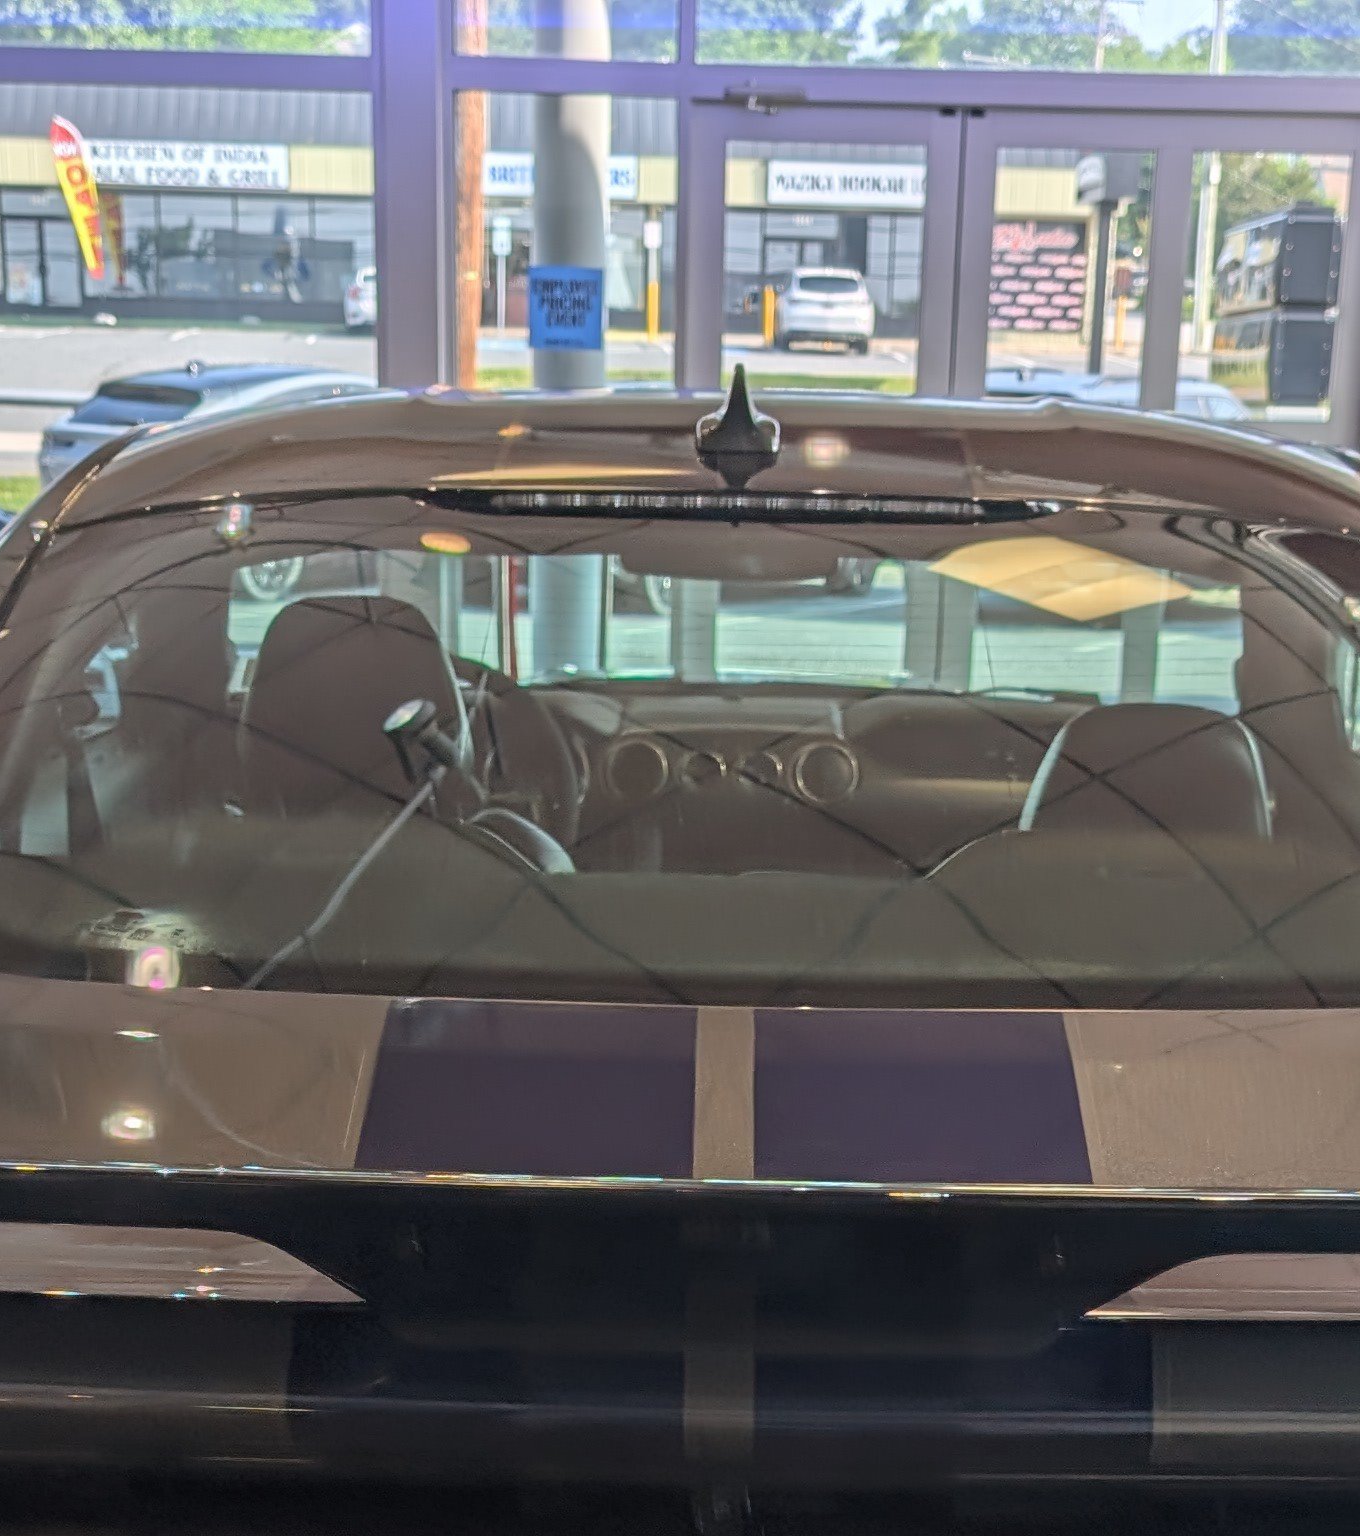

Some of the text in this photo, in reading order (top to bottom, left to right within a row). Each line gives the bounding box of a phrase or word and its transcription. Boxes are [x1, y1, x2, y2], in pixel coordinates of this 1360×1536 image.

[90, 145, 270, 165] KITCHEN OF INDIA
[145, 166, 200, 186] FOOD
[228, 169, 280, 189] GRILL
